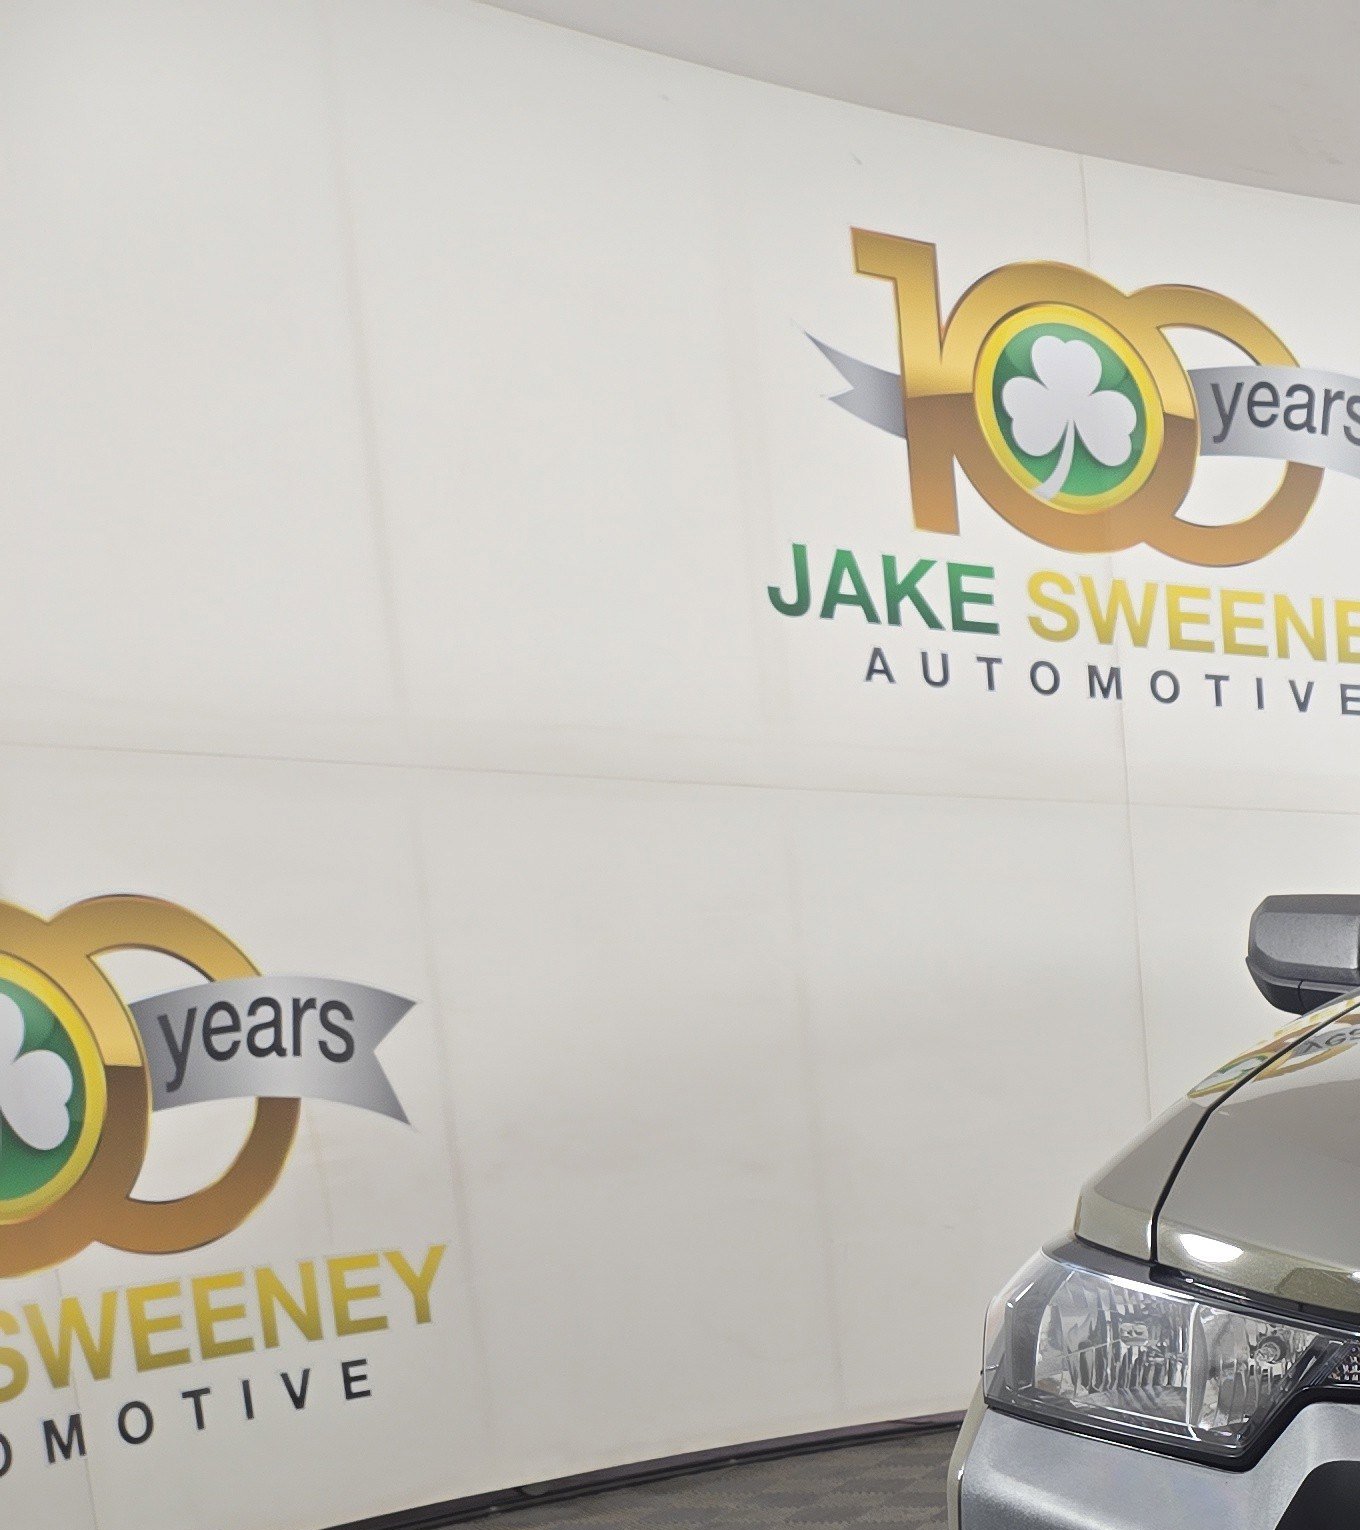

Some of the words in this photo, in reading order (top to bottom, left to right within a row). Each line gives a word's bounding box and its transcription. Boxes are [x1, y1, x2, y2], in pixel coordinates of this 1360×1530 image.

[850, 226, 1324, 567] 100
[767, 543, 1000, 635] JAKE
[157, 996, 356, 1092] years
